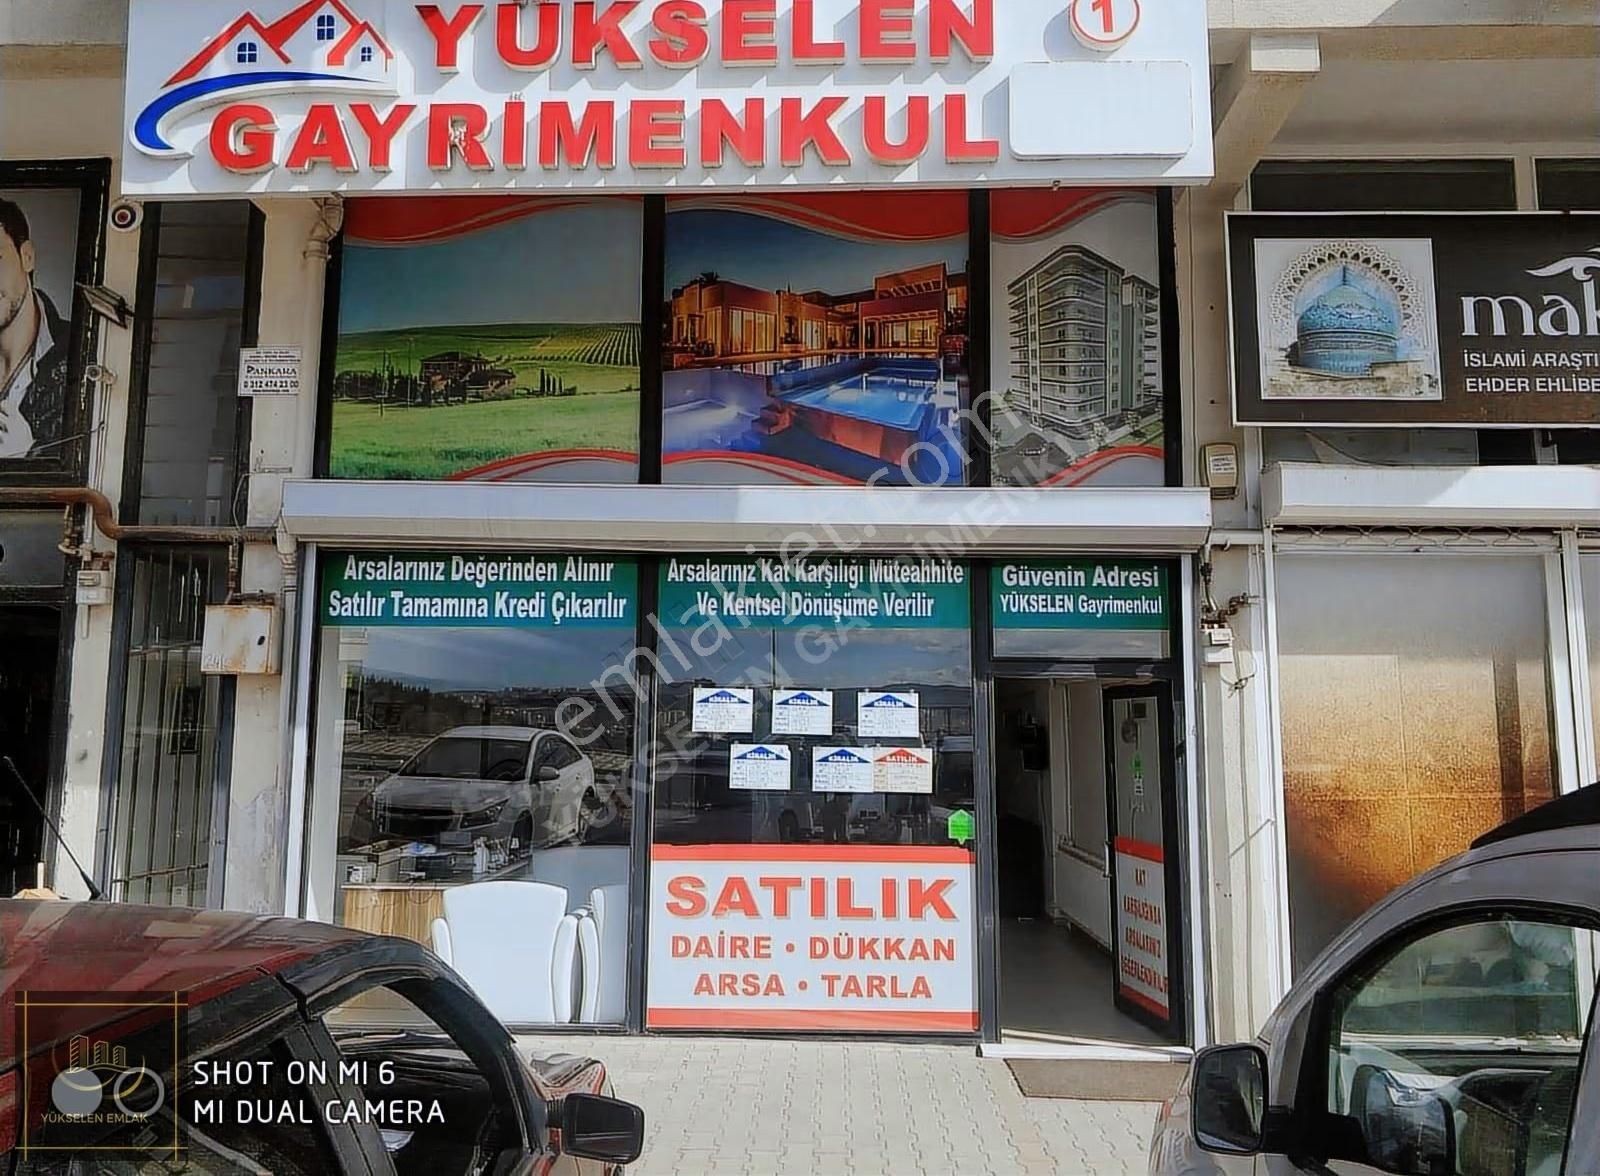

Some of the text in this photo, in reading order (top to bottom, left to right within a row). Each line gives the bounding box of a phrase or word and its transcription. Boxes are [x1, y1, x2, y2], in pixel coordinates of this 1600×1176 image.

[1463, 349, 1527, 368] İSLAMİ
[1466, 377, 1530, 392] EHDER
[344, 555, 614, 588] Arsalarınız Değerinden Alınır
[667, 558, 756, 583] Arsalarınız
[761, 559, 790, 582] Kat
[869, 558, 964, 584] Müteahhite
[1002, 565, 1159, 588] Güvenin Adresi
[328, 590, 627, 624] Satılır Tamamına Kredi Çıkarılır
[697, 591, 934, 622] Ve Kentsel Dönüşüme Verilir
[1000, 591, 1162, 618] YÜKSELEN Gayrimenkul
[666, 875, 958, 920] SATILIK
[671, 930, 955, 961] DAİRE DÜKKAN
[694, 973, 932, 998] ARSA TARLA
